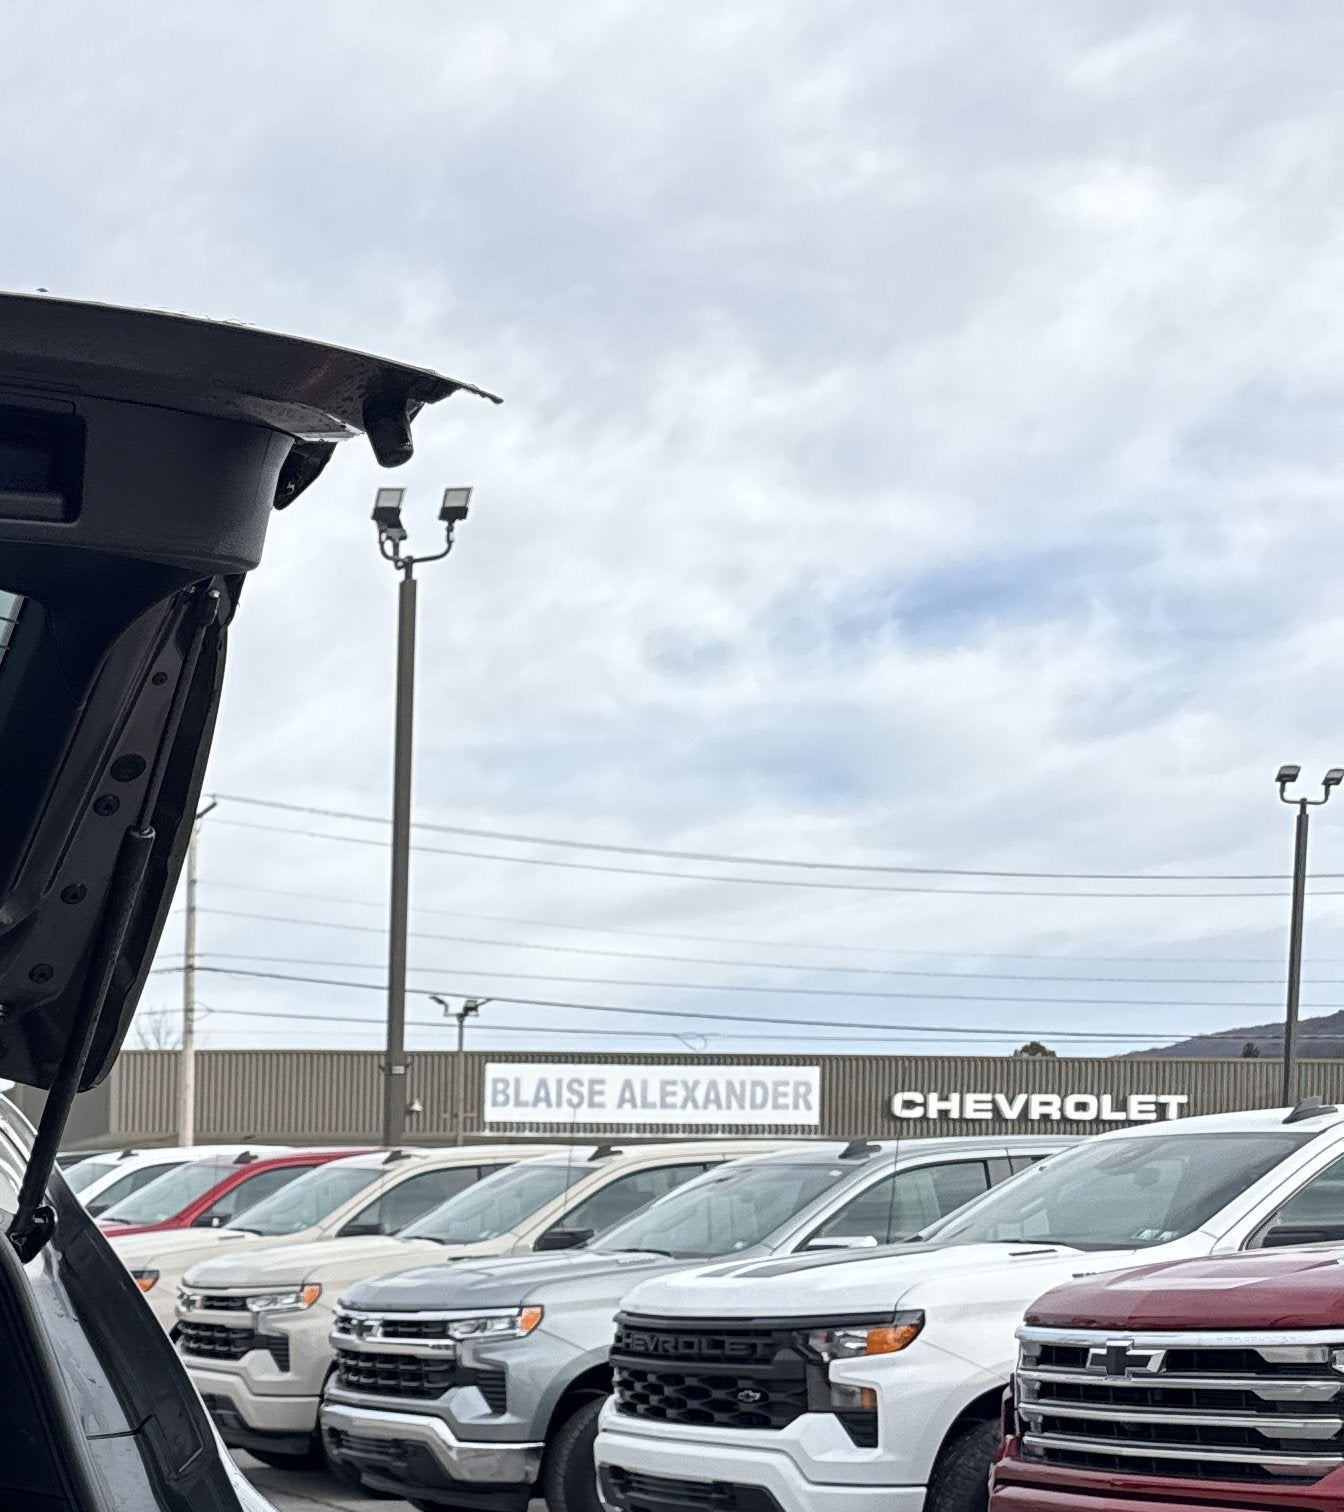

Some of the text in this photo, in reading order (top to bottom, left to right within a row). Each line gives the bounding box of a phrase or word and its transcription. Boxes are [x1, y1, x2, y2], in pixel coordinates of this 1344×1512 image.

[490, 1077, 813, 1111] BLAISE ALEXANDER
[891, 1091, 1188, 1120] CHEVROLET
